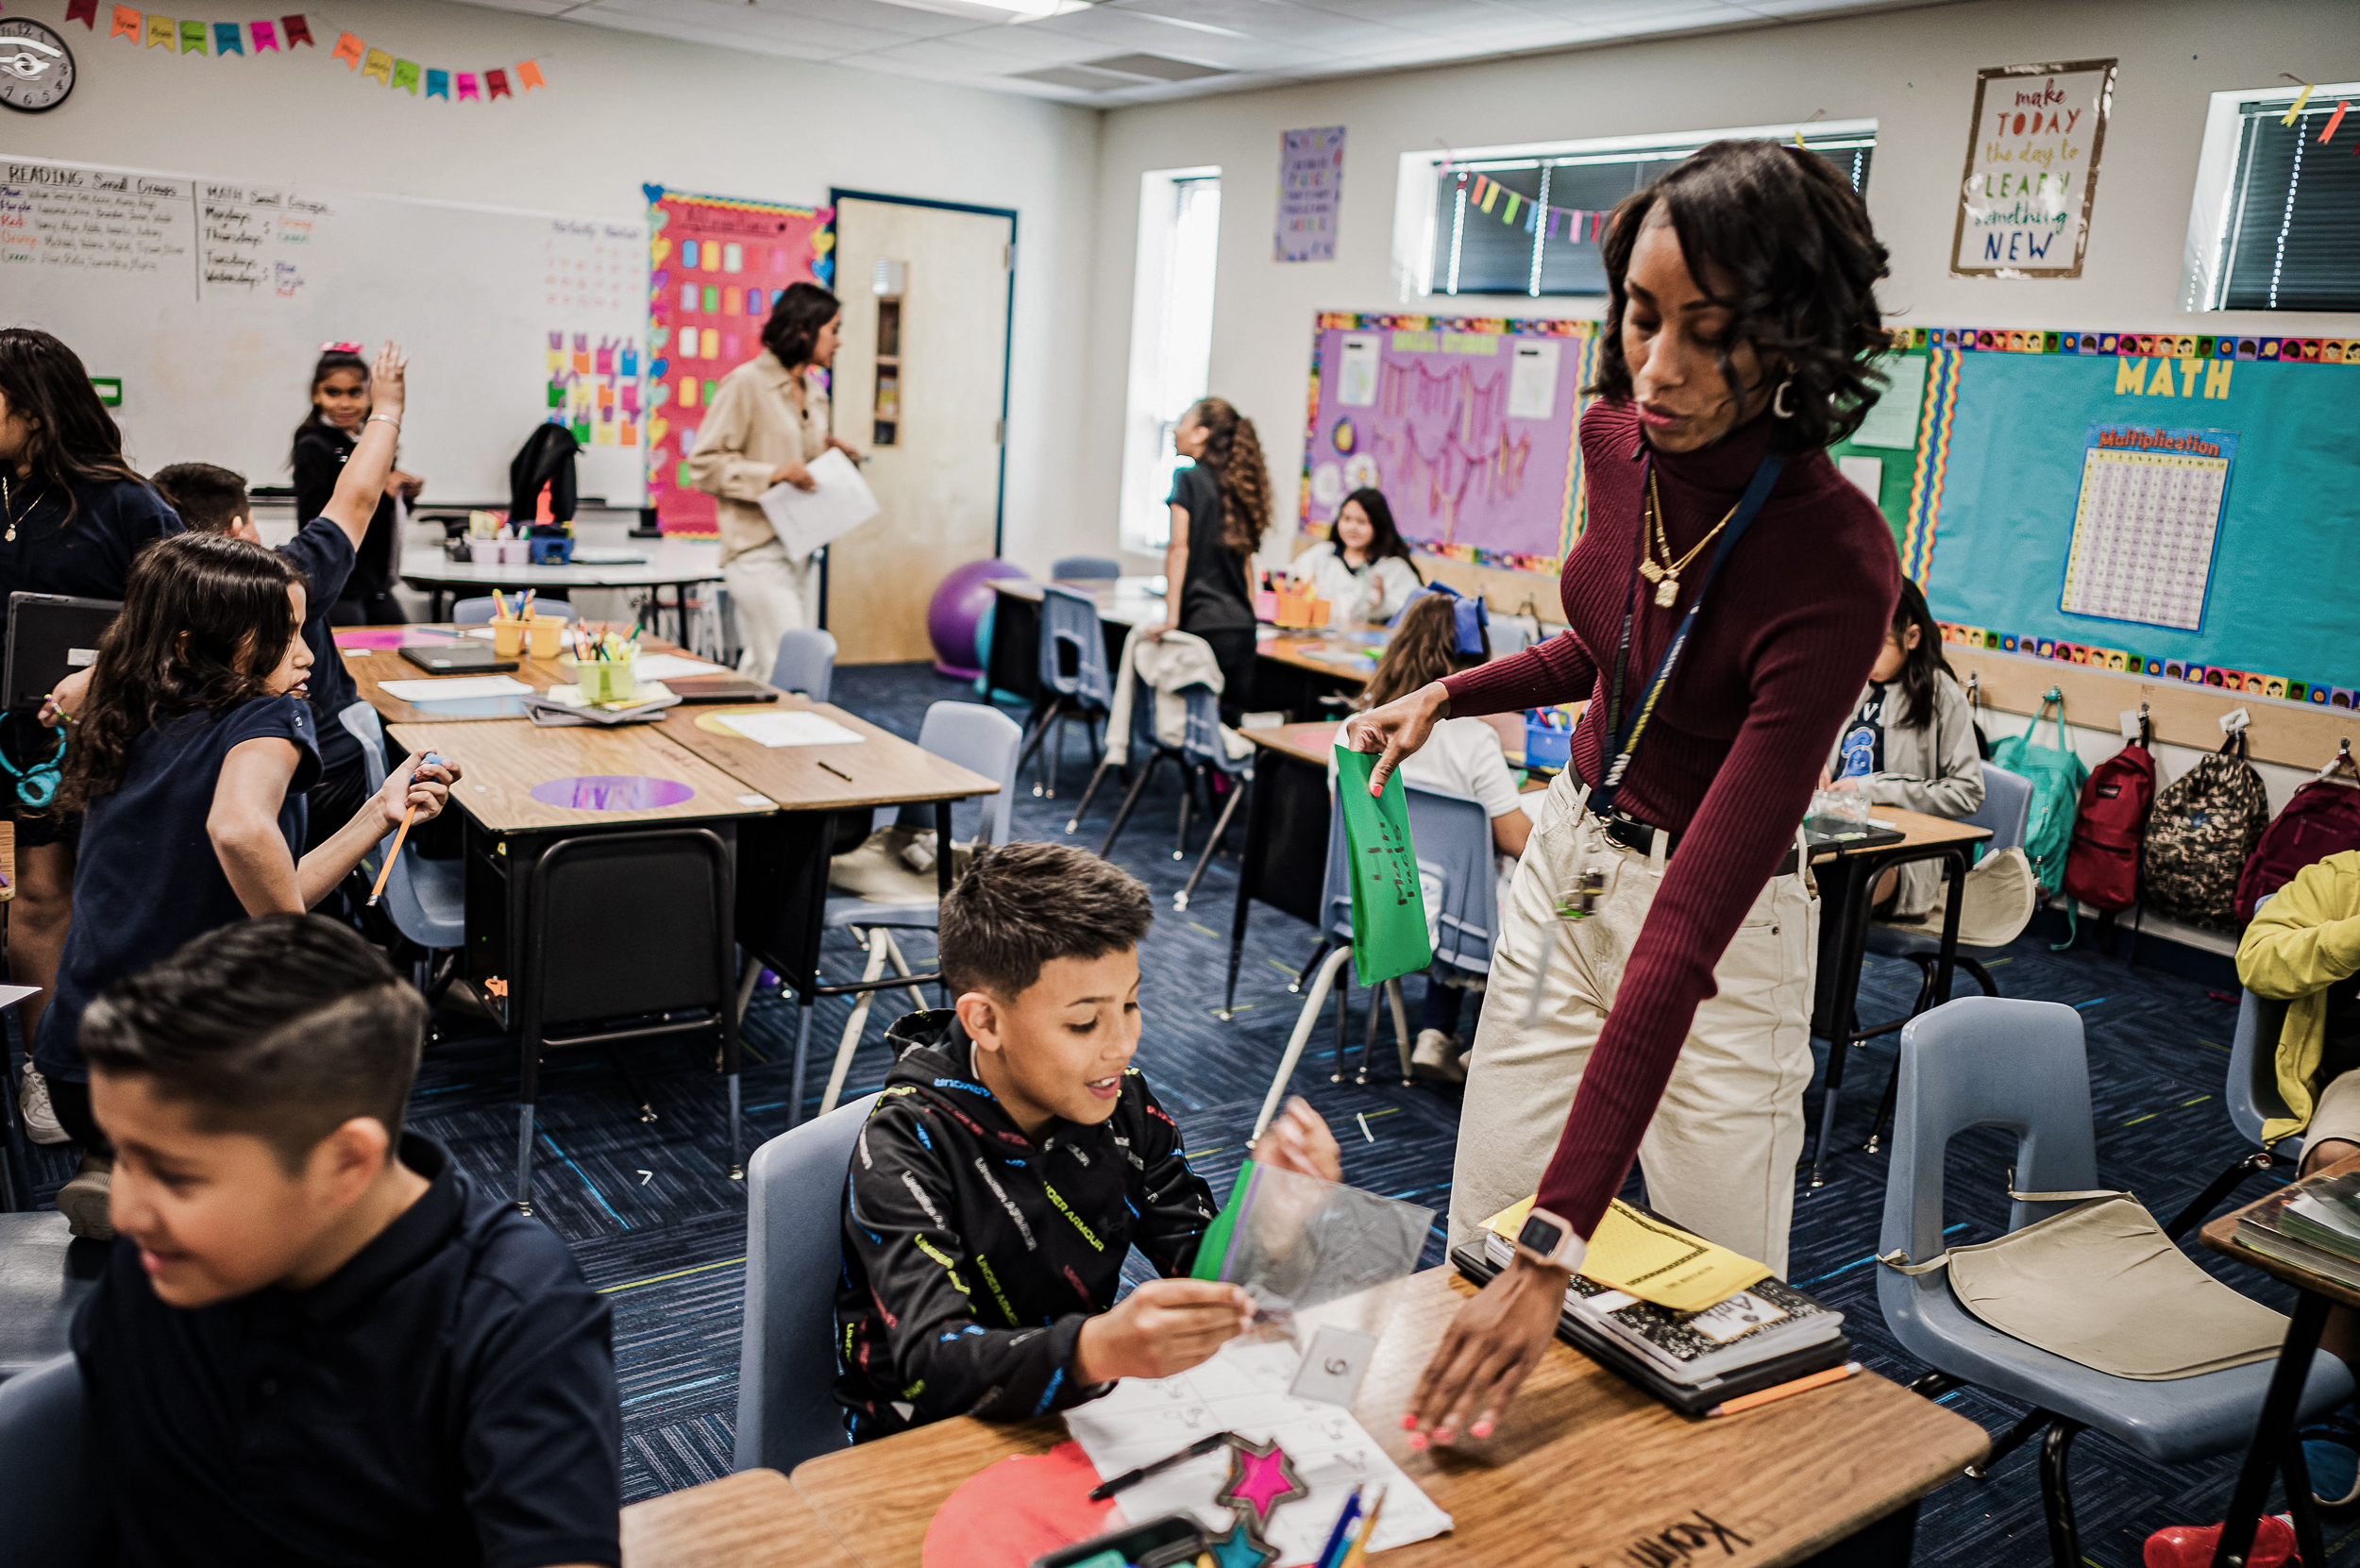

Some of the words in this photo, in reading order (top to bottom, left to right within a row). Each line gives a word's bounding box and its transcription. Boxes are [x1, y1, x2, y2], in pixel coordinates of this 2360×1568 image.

[17, 23, 32, 36] 12
[5, 86, 13, 99] 7
[24, 93, 32, 105] 6
[42, 90, 50, 103] 5
[55, 79, 63, 92] 4
[2014, 76, 2067, 109] make
[1997, 108, 2082, 138] TODAY
[1986, 141, 2013, 163] the
[2019, 140, 2054, 169] day
[2062, 138, 2079, 160] to
[8, 164, 85, 188] READING
[207, 186, 243, 199] MATH
[1984, 231, 2053, 261] NEW
[2115, 355, 2234, 399] MATH
[2099, 429, 2220, 457] Multiplication
[1064, 1210, 1104, 1253] ARMOUR
[975, 1253, 1002, 1295] UNDER
